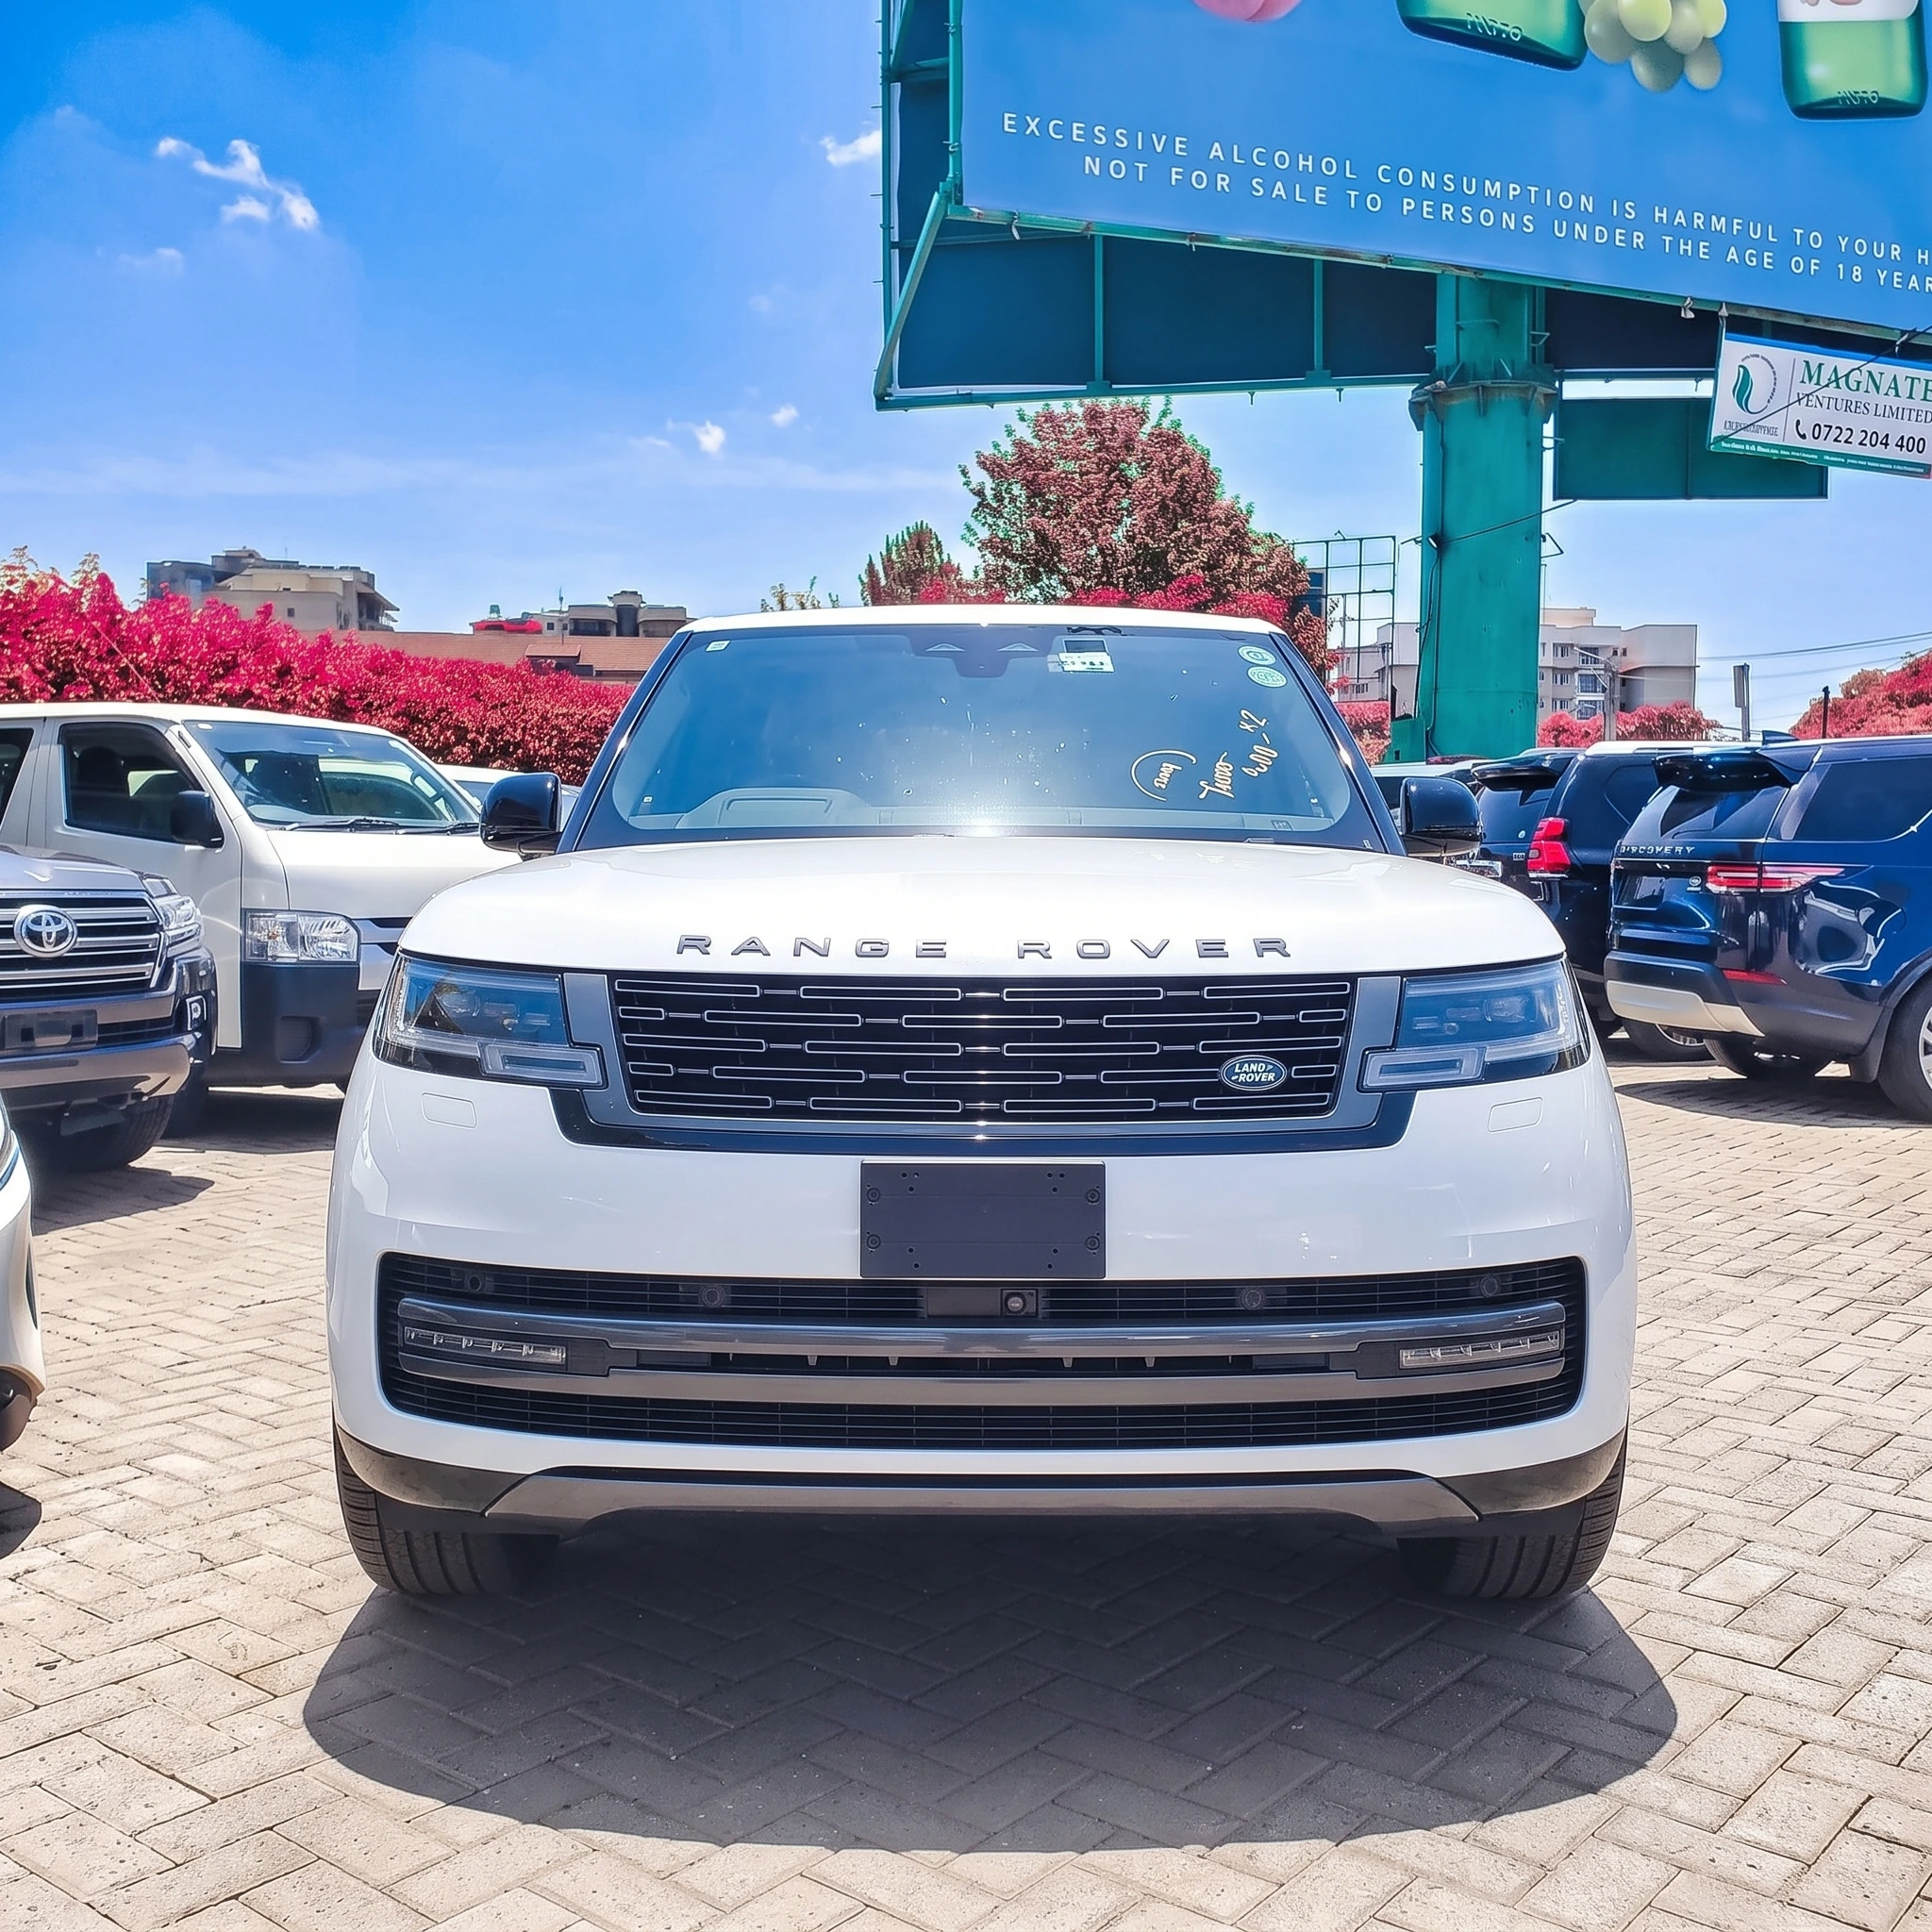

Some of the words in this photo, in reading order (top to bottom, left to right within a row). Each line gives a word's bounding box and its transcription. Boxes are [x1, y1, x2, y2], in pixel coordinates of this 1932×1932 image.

[1002, 111, 1190, 157] EXCESSIVE
[1208, 142, 1358, 180] ALCOHOL
[1376, 164, 1595, 214] CONSUMPTION
[1611, 199, 1638, 220] IS
[1654, 206, 1779, 243] HARMFUL
[1792, 227, 1824, 250] TO
[1837, 235, 1903, 262] YOUR
[1084, 156, 1149, 183] NOT
[1171, 167, 1231, 192] FOR
[1251, 177, 1328, 207] SALE
[1346, 190, 1383, 213] TO
[1402, 197, 1536, 234] PERSONS
[1553, 220, 1646, 251] UNDER
[1661, 235, 1712, 260] THE
[1725, 245, 1775, 271] AGE
[1790, 256, 1822, 276] OF
[1837, 262, 1863, 283] 18
[1799, 359, 1932, 403] MAGNATE
[1796, 392, 1871, 416] VENTURES
[1874, 403, 1932, 424] LIMITED
[1811, 423, 1855, 445] 0722
[1857, 428, 1890, 451] 204
[1894, 435, 1926, 455] 400
[1620, 845, 1695, 855] DISCOVERY
[676, 934, 947, 958] RANGE
[1017, 937, 1291, 959] ROVER
[1234, 1063, 1265, 1073] LAND
[1238, 1073, 1275, 1082] ROVER
